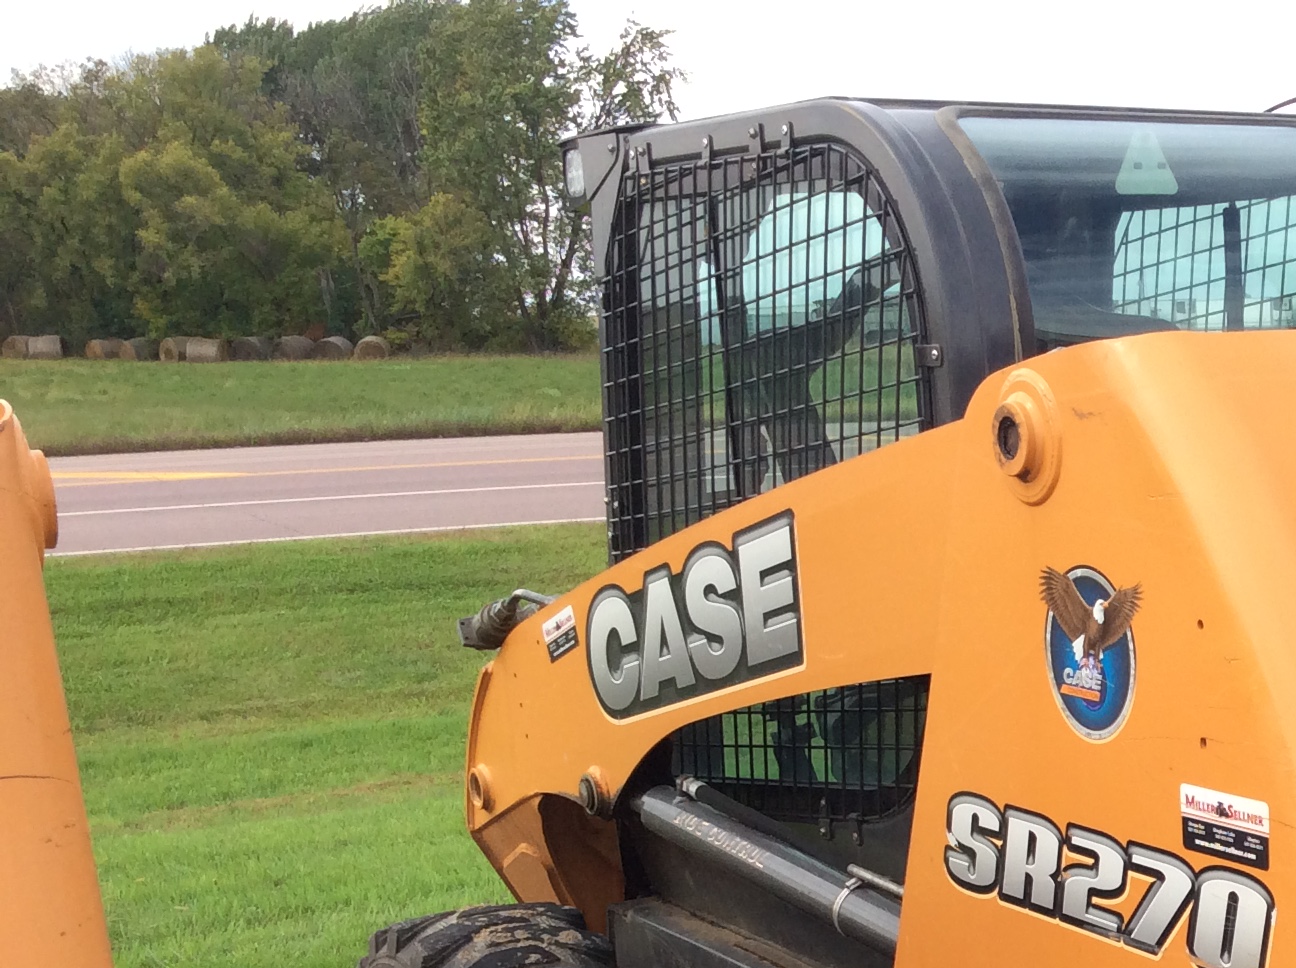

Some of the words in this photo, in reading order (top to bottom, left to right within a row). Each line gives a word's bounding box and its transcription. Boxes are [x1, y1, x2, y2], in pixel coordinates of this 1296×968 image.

[590, 511, 801, 716] CASE
[1063, 667, 1102, 690] CASE
[1185, 794, 1216, 815] MILLER
[1227, 804, 1264, 827] SELLNER
